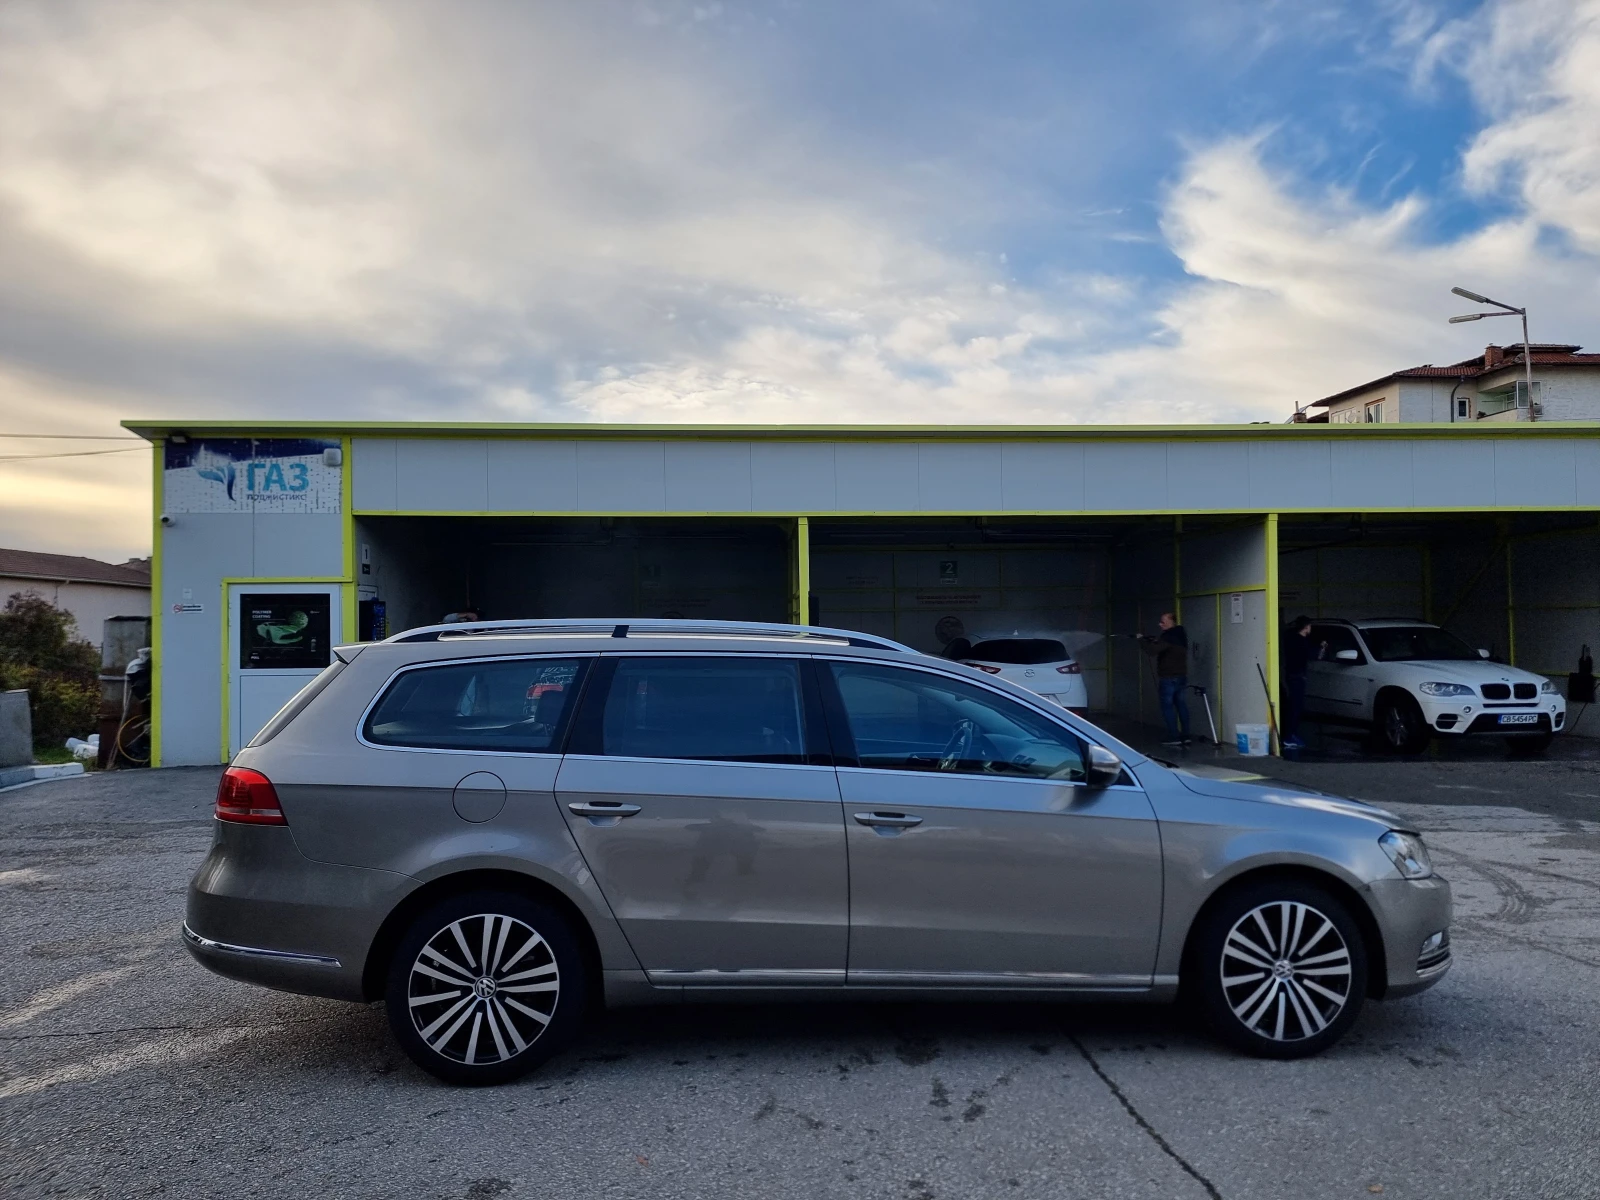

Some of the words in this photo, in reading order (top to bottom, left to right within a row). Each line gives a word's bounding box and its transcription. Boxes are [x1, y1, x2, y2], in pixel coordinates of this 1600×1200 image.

[247, 463, 309, 491] ГАЗ
[945, 562, 954, 574] 2
[1502, 715, 1511, 723] CB
[1511, 715, 1527, 723] 5454
[1528, 715, 1537, 723] PC
